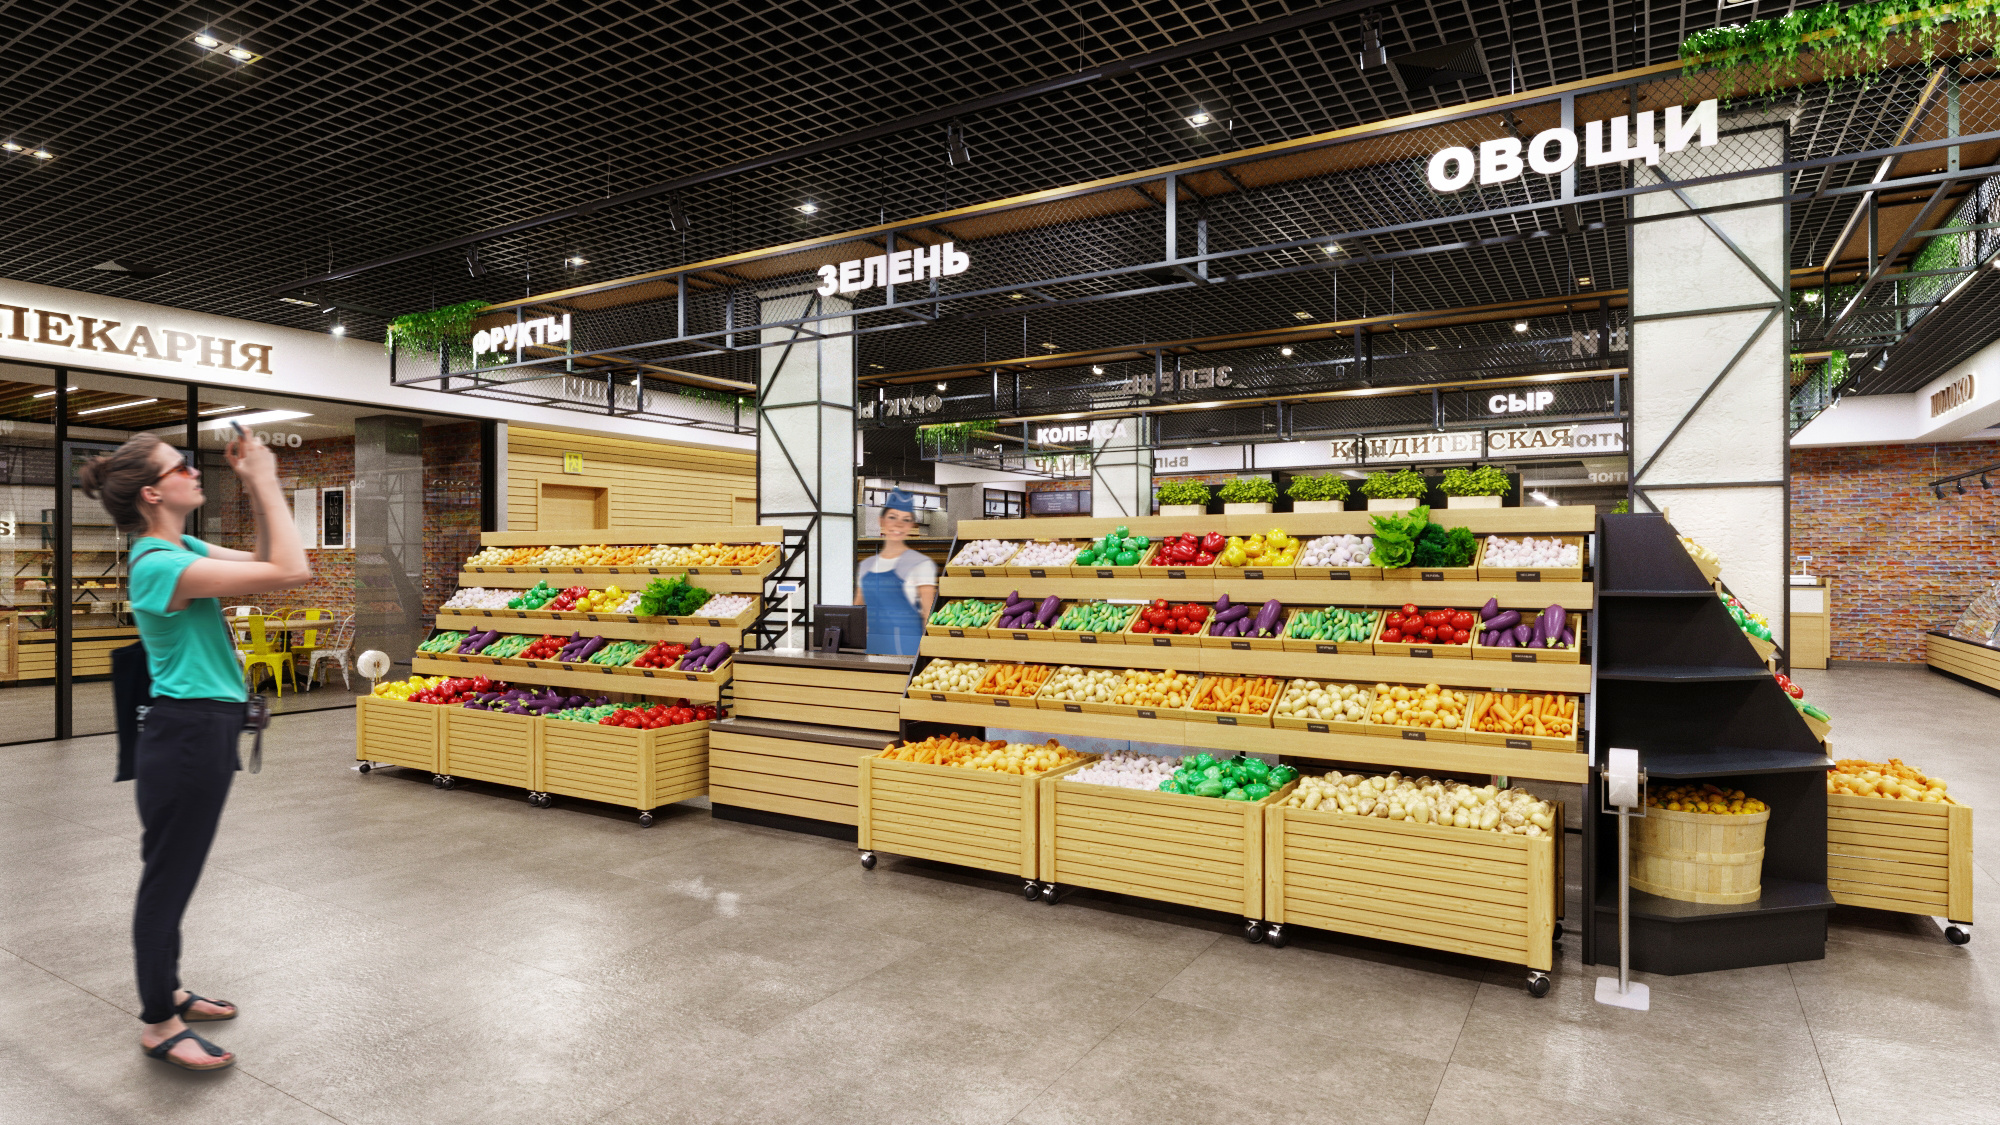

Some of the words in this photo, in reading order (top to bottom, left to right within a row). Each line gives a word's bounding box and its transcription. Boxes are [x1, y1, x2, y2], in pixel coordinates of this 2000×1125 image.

[1428, 98, 1718, 192] ОВОЩИ
[817, 242, 970, 297] ЗЕЛЕНЬ
[0, 304, 273, 375] ПЕКАРНЯ
[473, 314, 571, 354] ФРУКТЫ
[1488, 391, 1554, 414] СЫР
[1930, 375, 1974, 418] МОЛОКО
[1037, 423, 1127, 444] КОЛБАСА
[1331, 428, 1572, 458] КОНДИТЕРСКАЯ
